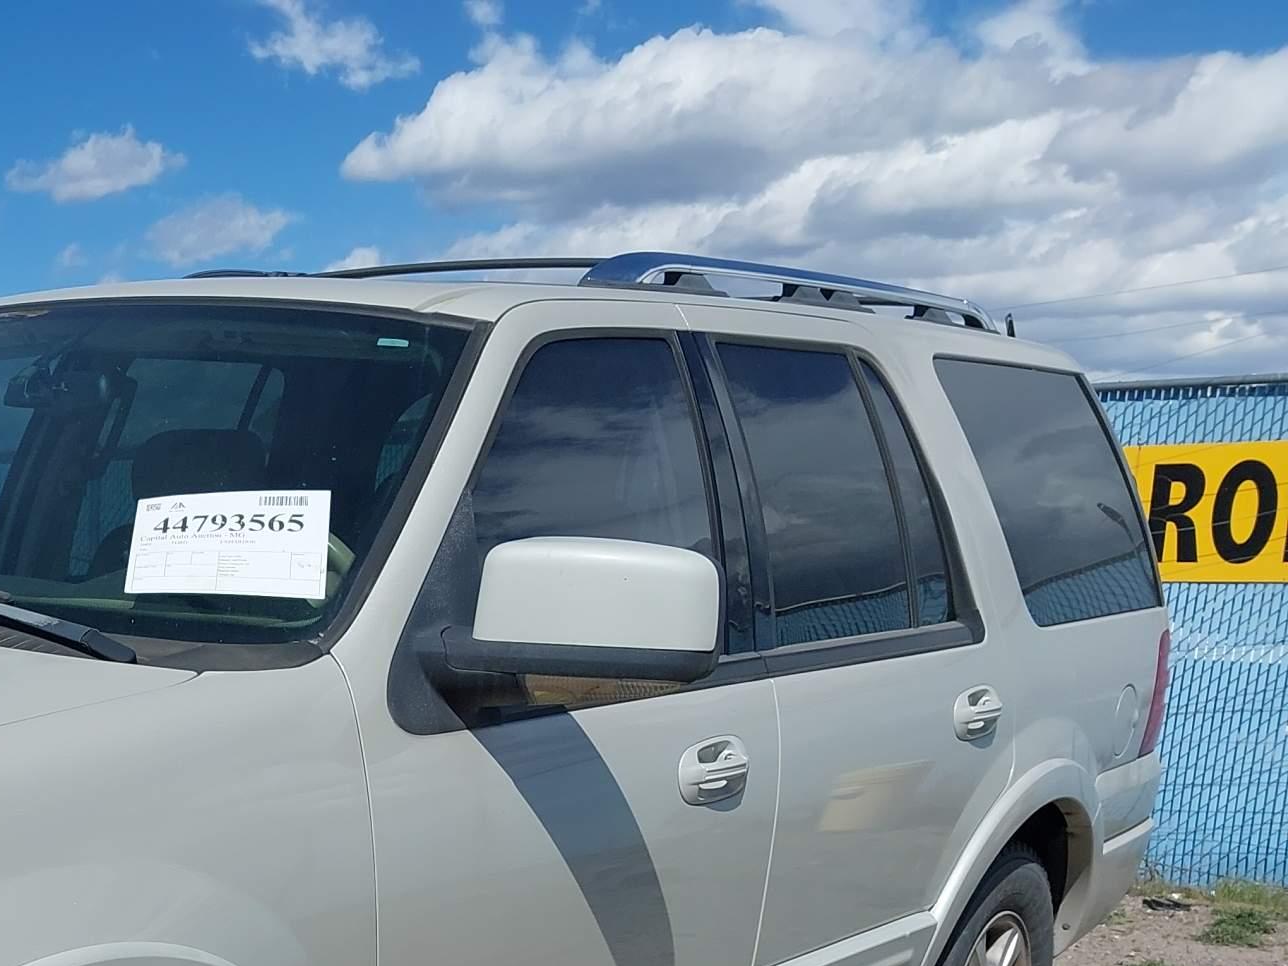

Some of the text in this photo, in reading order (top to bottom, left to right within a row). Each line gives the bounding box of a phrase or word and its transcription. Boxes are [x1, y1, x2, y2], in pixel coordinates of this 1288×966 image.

[1148, 459, 1288, 564] RO
[153, 513, 305, 534] 44793565
[140, 534, 167, 543] Capital
